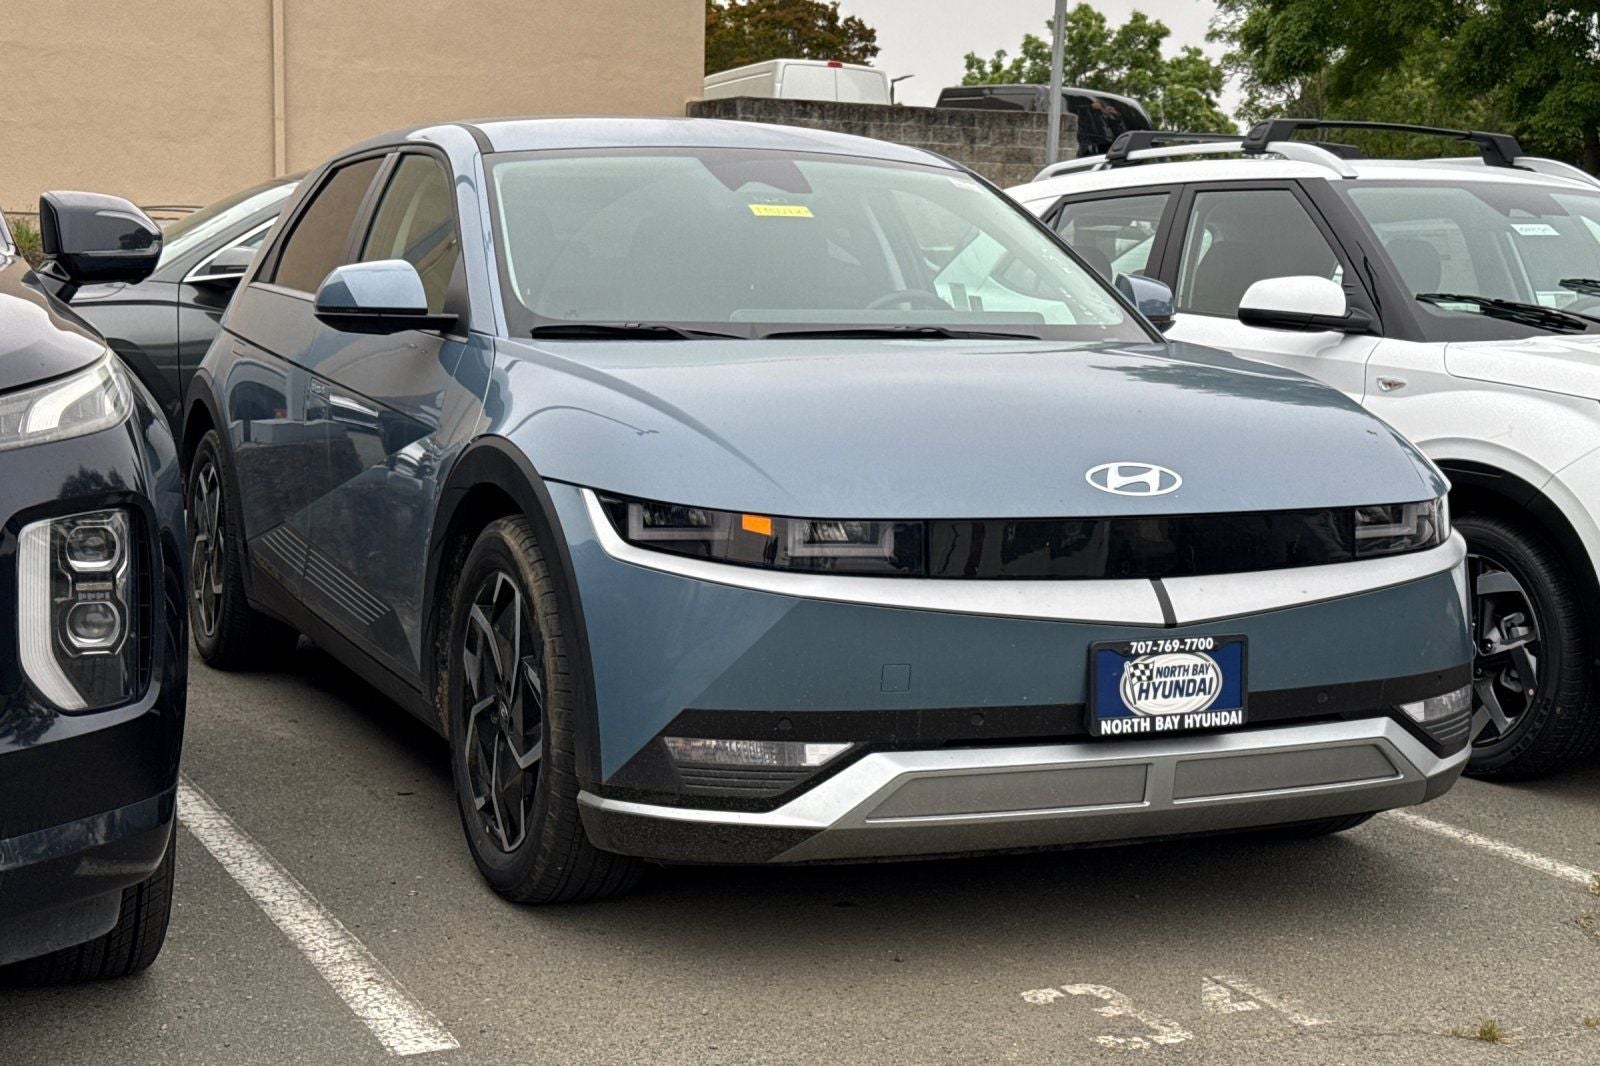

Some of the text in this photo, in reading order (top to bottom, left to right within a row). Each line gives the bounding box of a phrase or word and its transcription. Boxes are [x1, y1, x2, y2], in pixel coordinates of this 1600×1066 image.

[1130, 638, 1214, 654] 707-769-7700
[1155, 663, 1211, 679] NORTH BAY
[1137, 677, 1213, 701] HYUNDAI
[1101, 711, 1242, 735] NORTH BAY HYUNDAI
